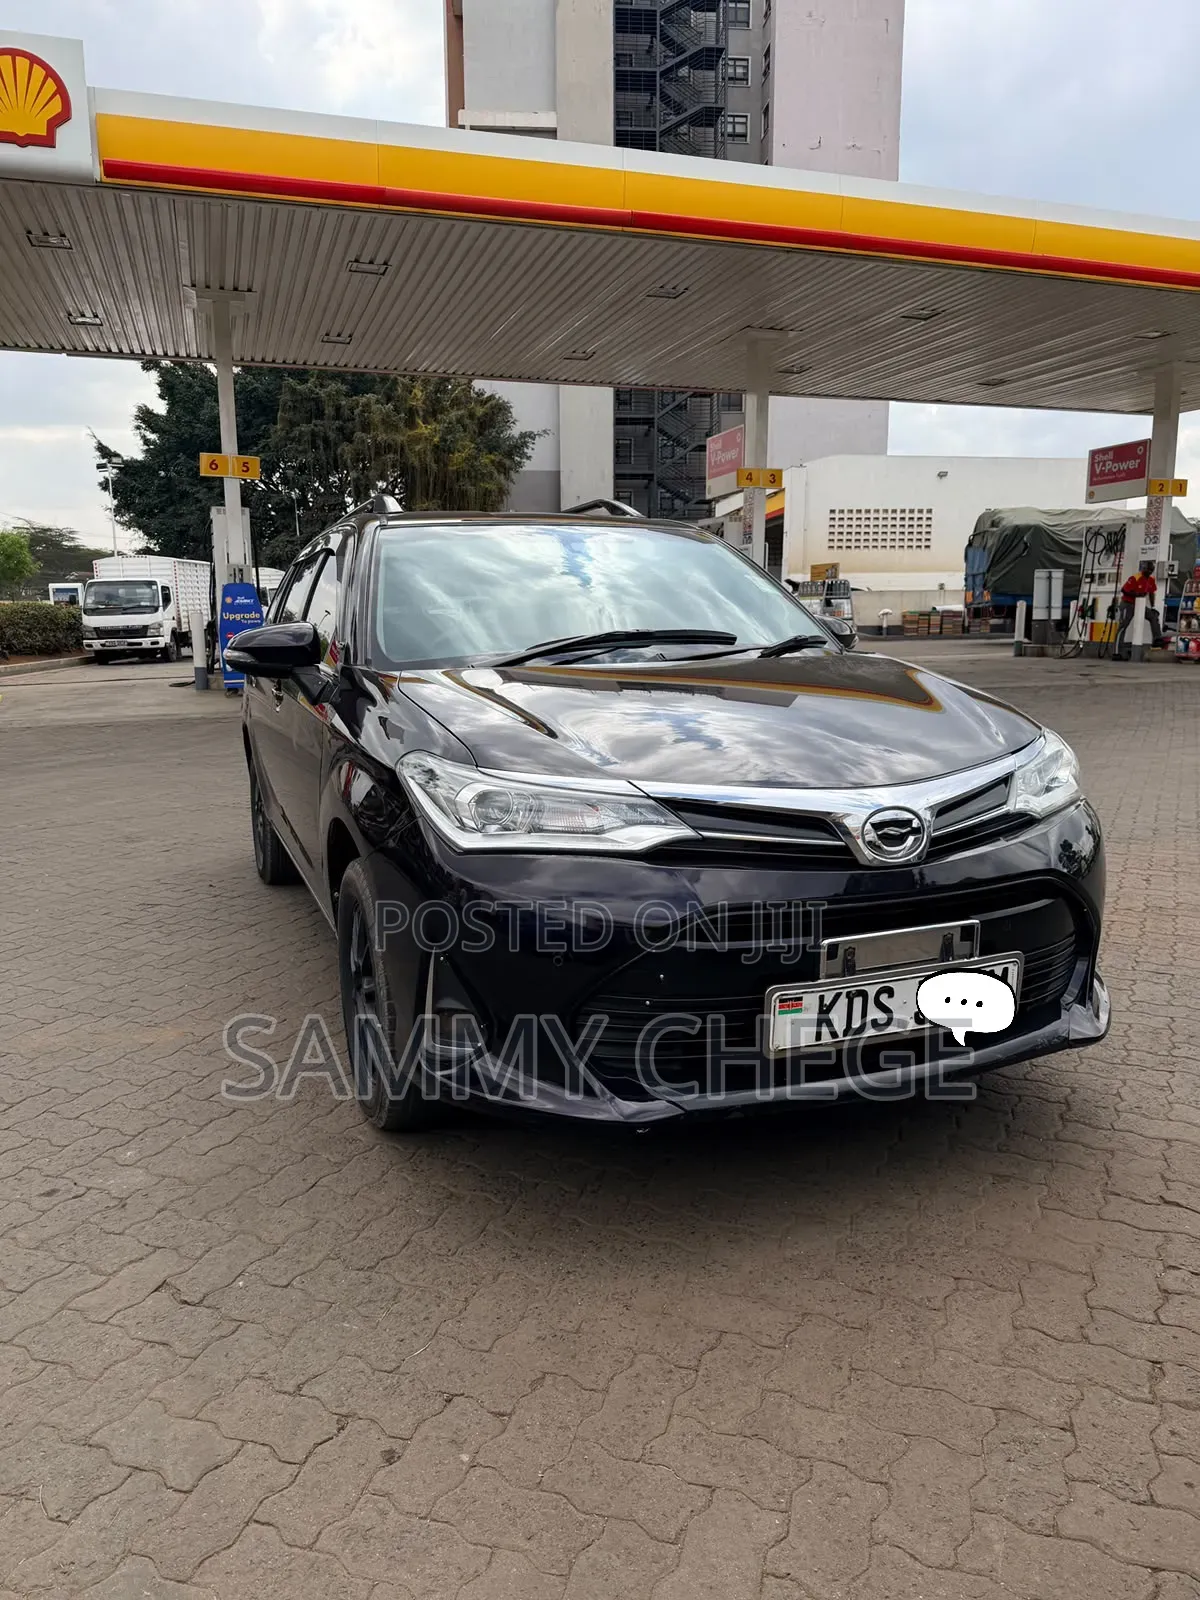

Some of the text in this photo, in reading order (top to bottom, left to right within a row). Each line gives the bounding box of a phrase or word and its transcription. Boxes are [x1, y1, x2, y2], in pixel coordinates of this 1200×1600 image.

[711, 448, 739, 466] V-Power
[1094, 451, 1114, 463] Shell
[209, 459, 250, 473] 6 5
[1094, 458, 1141, 475] V-Power
[745, 472, 777, 484] 4 3
[1158, 483, 1165, 492] 2
[222, 611, 261, 621] Upgrade
[815, 985, 895, 1042] KDS
